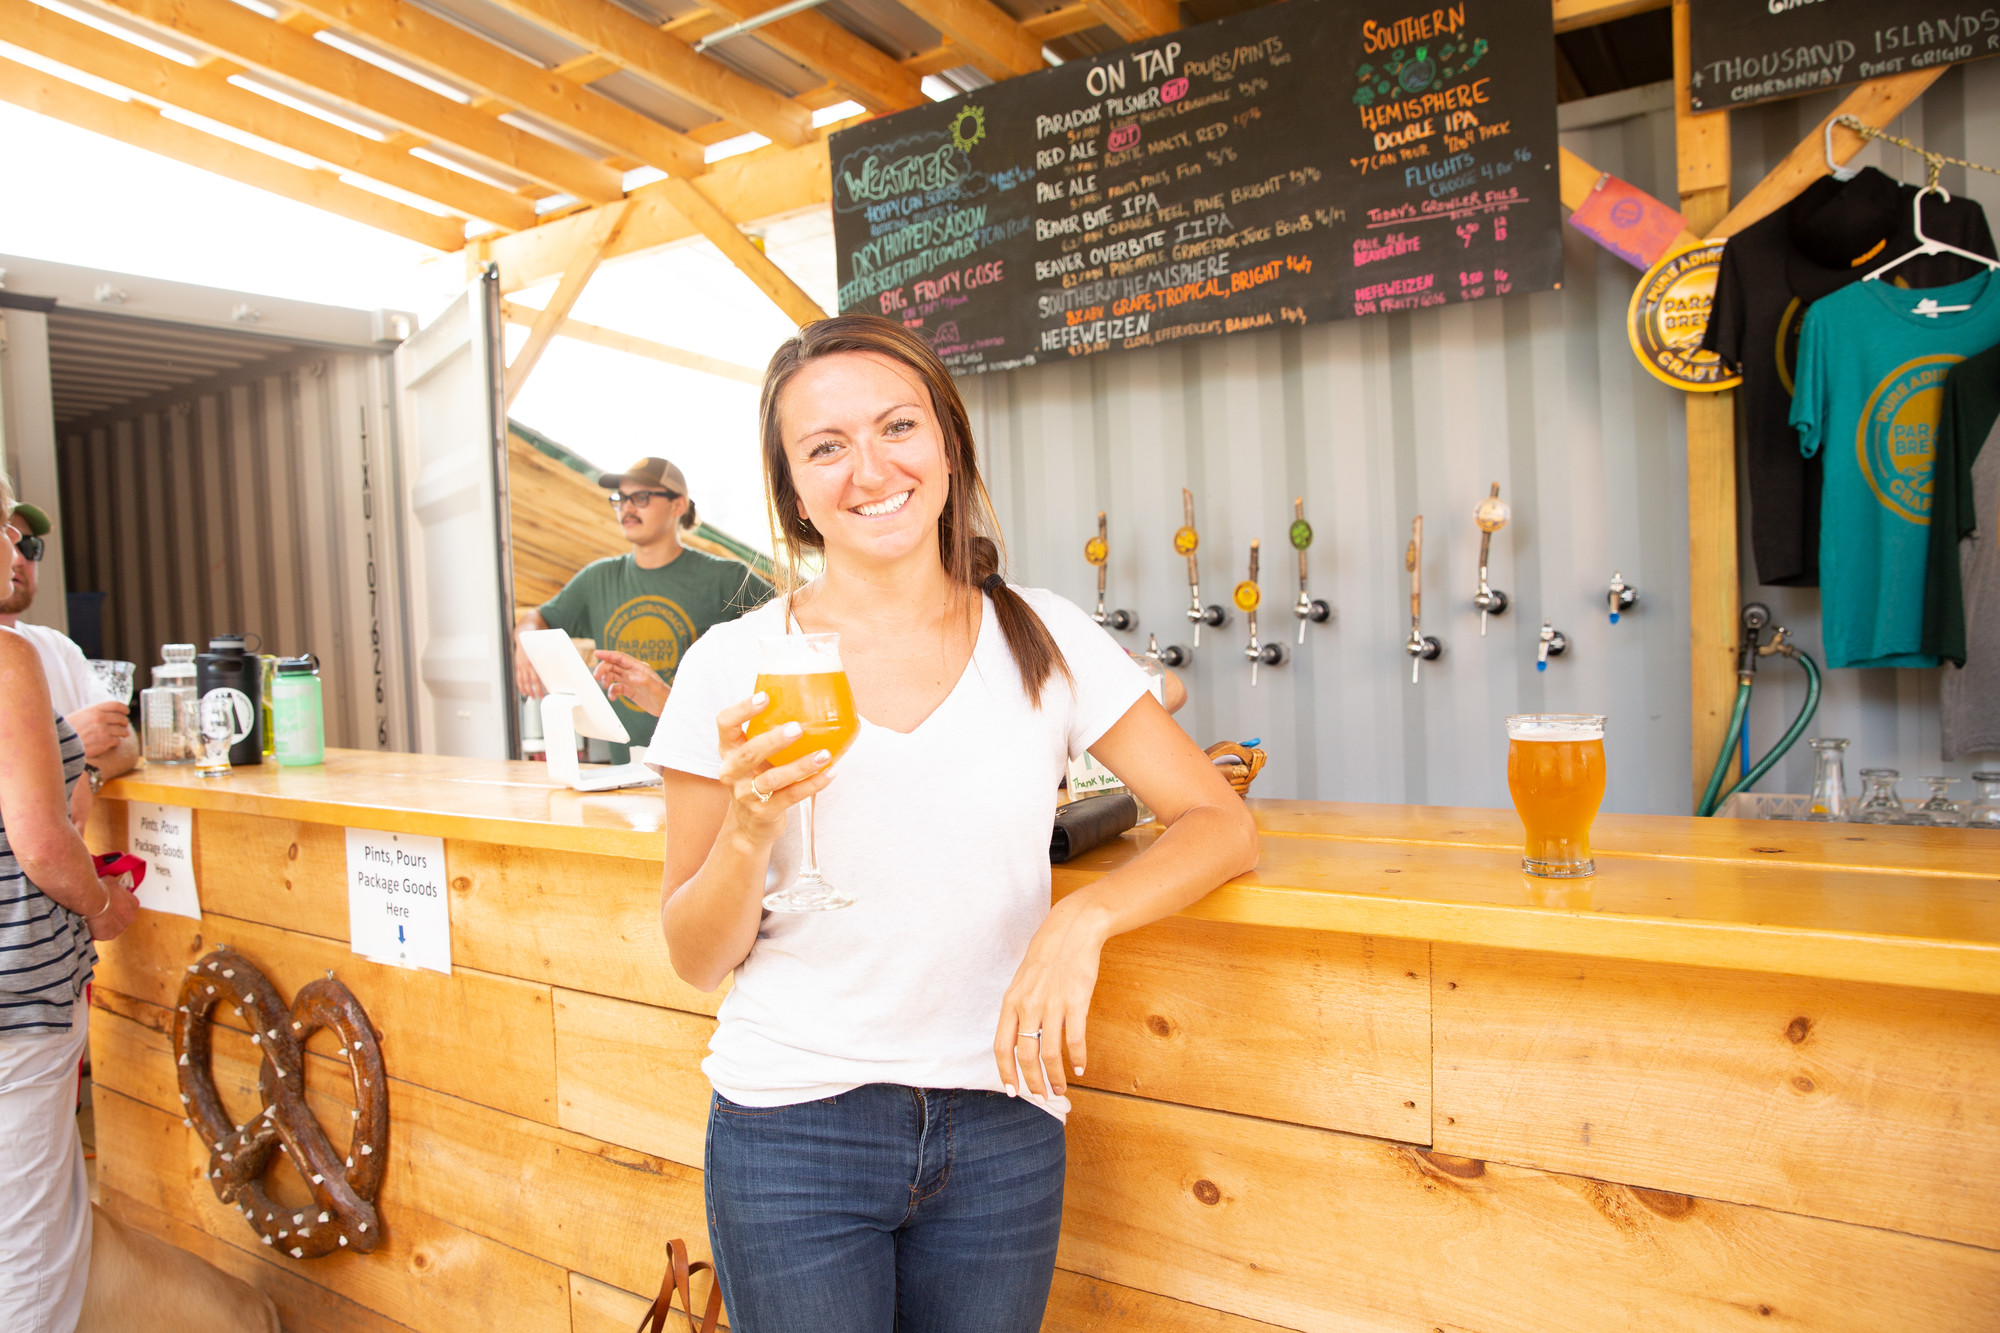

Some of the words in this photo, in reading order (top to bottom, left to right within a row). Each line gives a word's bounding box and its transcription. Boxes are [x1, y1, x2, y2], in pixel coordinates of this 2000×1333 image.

[1363, 1, 1466, 55] SOUTHERN
[1704, 39, 1856, 85] THOUSAND
[1874, 8, 2000, 54] ISLANDS
[1086, 59, 1126, 97] ON
[1132, 42, 1182, 83] TAP
[1730, 64, 1844, 101] CHARDONNAY
[1858, 57, 1904, 78] PINOT
[1910, 44, 1973, 68] GRIGIO
[1036, 102, 1103, 140] PARADOX
[1105, 86, 1162, 118] PILSNER
[1360, 77, 1491, 132] HEMISPHERE
[1195, 122, 1229, 144] RED
[1373, 117, 1437, 152] DOUBLE
[1445, 110, 1480, 133] IPA
[1036, 147, 1066, 170] RED
[1069, 140, 1099, 162] ALE
[1370, 151, 1398, 171] CAN
[1404, 152, 1476, 188] FLIGHTS
[843, 143, 959, 203] WEATHER
[1480, 162, 1494, 181] 4
[1036, 180, 1066, 204] PALE
[1069, 174, 1099, 197] ALE
[1107, 212, 1155, 236] ORANGE
[1230, 173, 1287, 205] BRIGHT
[1421, 191, 1482, 214] GROWLER
[1485, 187, 1519, 204] FILLS
[1035, 214, 1083, 242] BEAVER
[1082, 204, 1115, 231] BITE
[1121, 192, 1161, 219] IPA
[851, 238, 883, 281] DRY
[883, 220, 932, 264] HOPPED
[932, 203, 988, 245] SAISON
[1035, 252, 1086, 281] BEAVER
[1089, 230, 1167, 266] OVERBITE
[1174, 212, 1235, 243] IIPA
[878, 287, 908, 316] BIG
[912, 270, 962, 304] FRUITY
[963, 259, 1005, 291] GOSE
[1038, 280, 1118, 319] SOUTHERN
[1119, 252, 1231, 300] HEMISPHERE
[1112, 292, 1157, 317] GRAPE,
[1154, 277, 1231, 310] TROPICAL,
[1230, 260, 1284, 293] BRIGHT
[1355, 273, 1434, 302] HEFEWEIZEN
[1646, 265, 1681, 303] PURE
[1664, 294, 1713, 313] PARA
[1041, 312, 1151, 351] HEFEWEIZEN
[1657, 350, 1719, 383] CRAFT
[1875, 382, 1910, 423] PURE
[1909, 369, 1949, 390] ADIR
[1893, 423, 1937, 440] PAR
[1894, 439, 1938, 456] BRE
[1889, 479, 1933, 511] CRAF
[610, 612, 629, 638] PURE
[617, 638, 675, 651] PARADOX
[625, 650, 674, 661] REWERY
[1072, 776, 1098, 790] Thank
[140, 815, 160, 835] Pints,
[159, 818, 180, 836] Pours
[133, 838, 162, 859] Package
[160, 842, 185, 860] Goods
[363, 845, 394, 867] Pints,
[395, 849, 428, 870] Pours
[154, 863, 172, 879] Here
[357, 871, 401, 895] Package
[401, 876, 439, 899] Goods
[385, 901, 410, 919] Here
